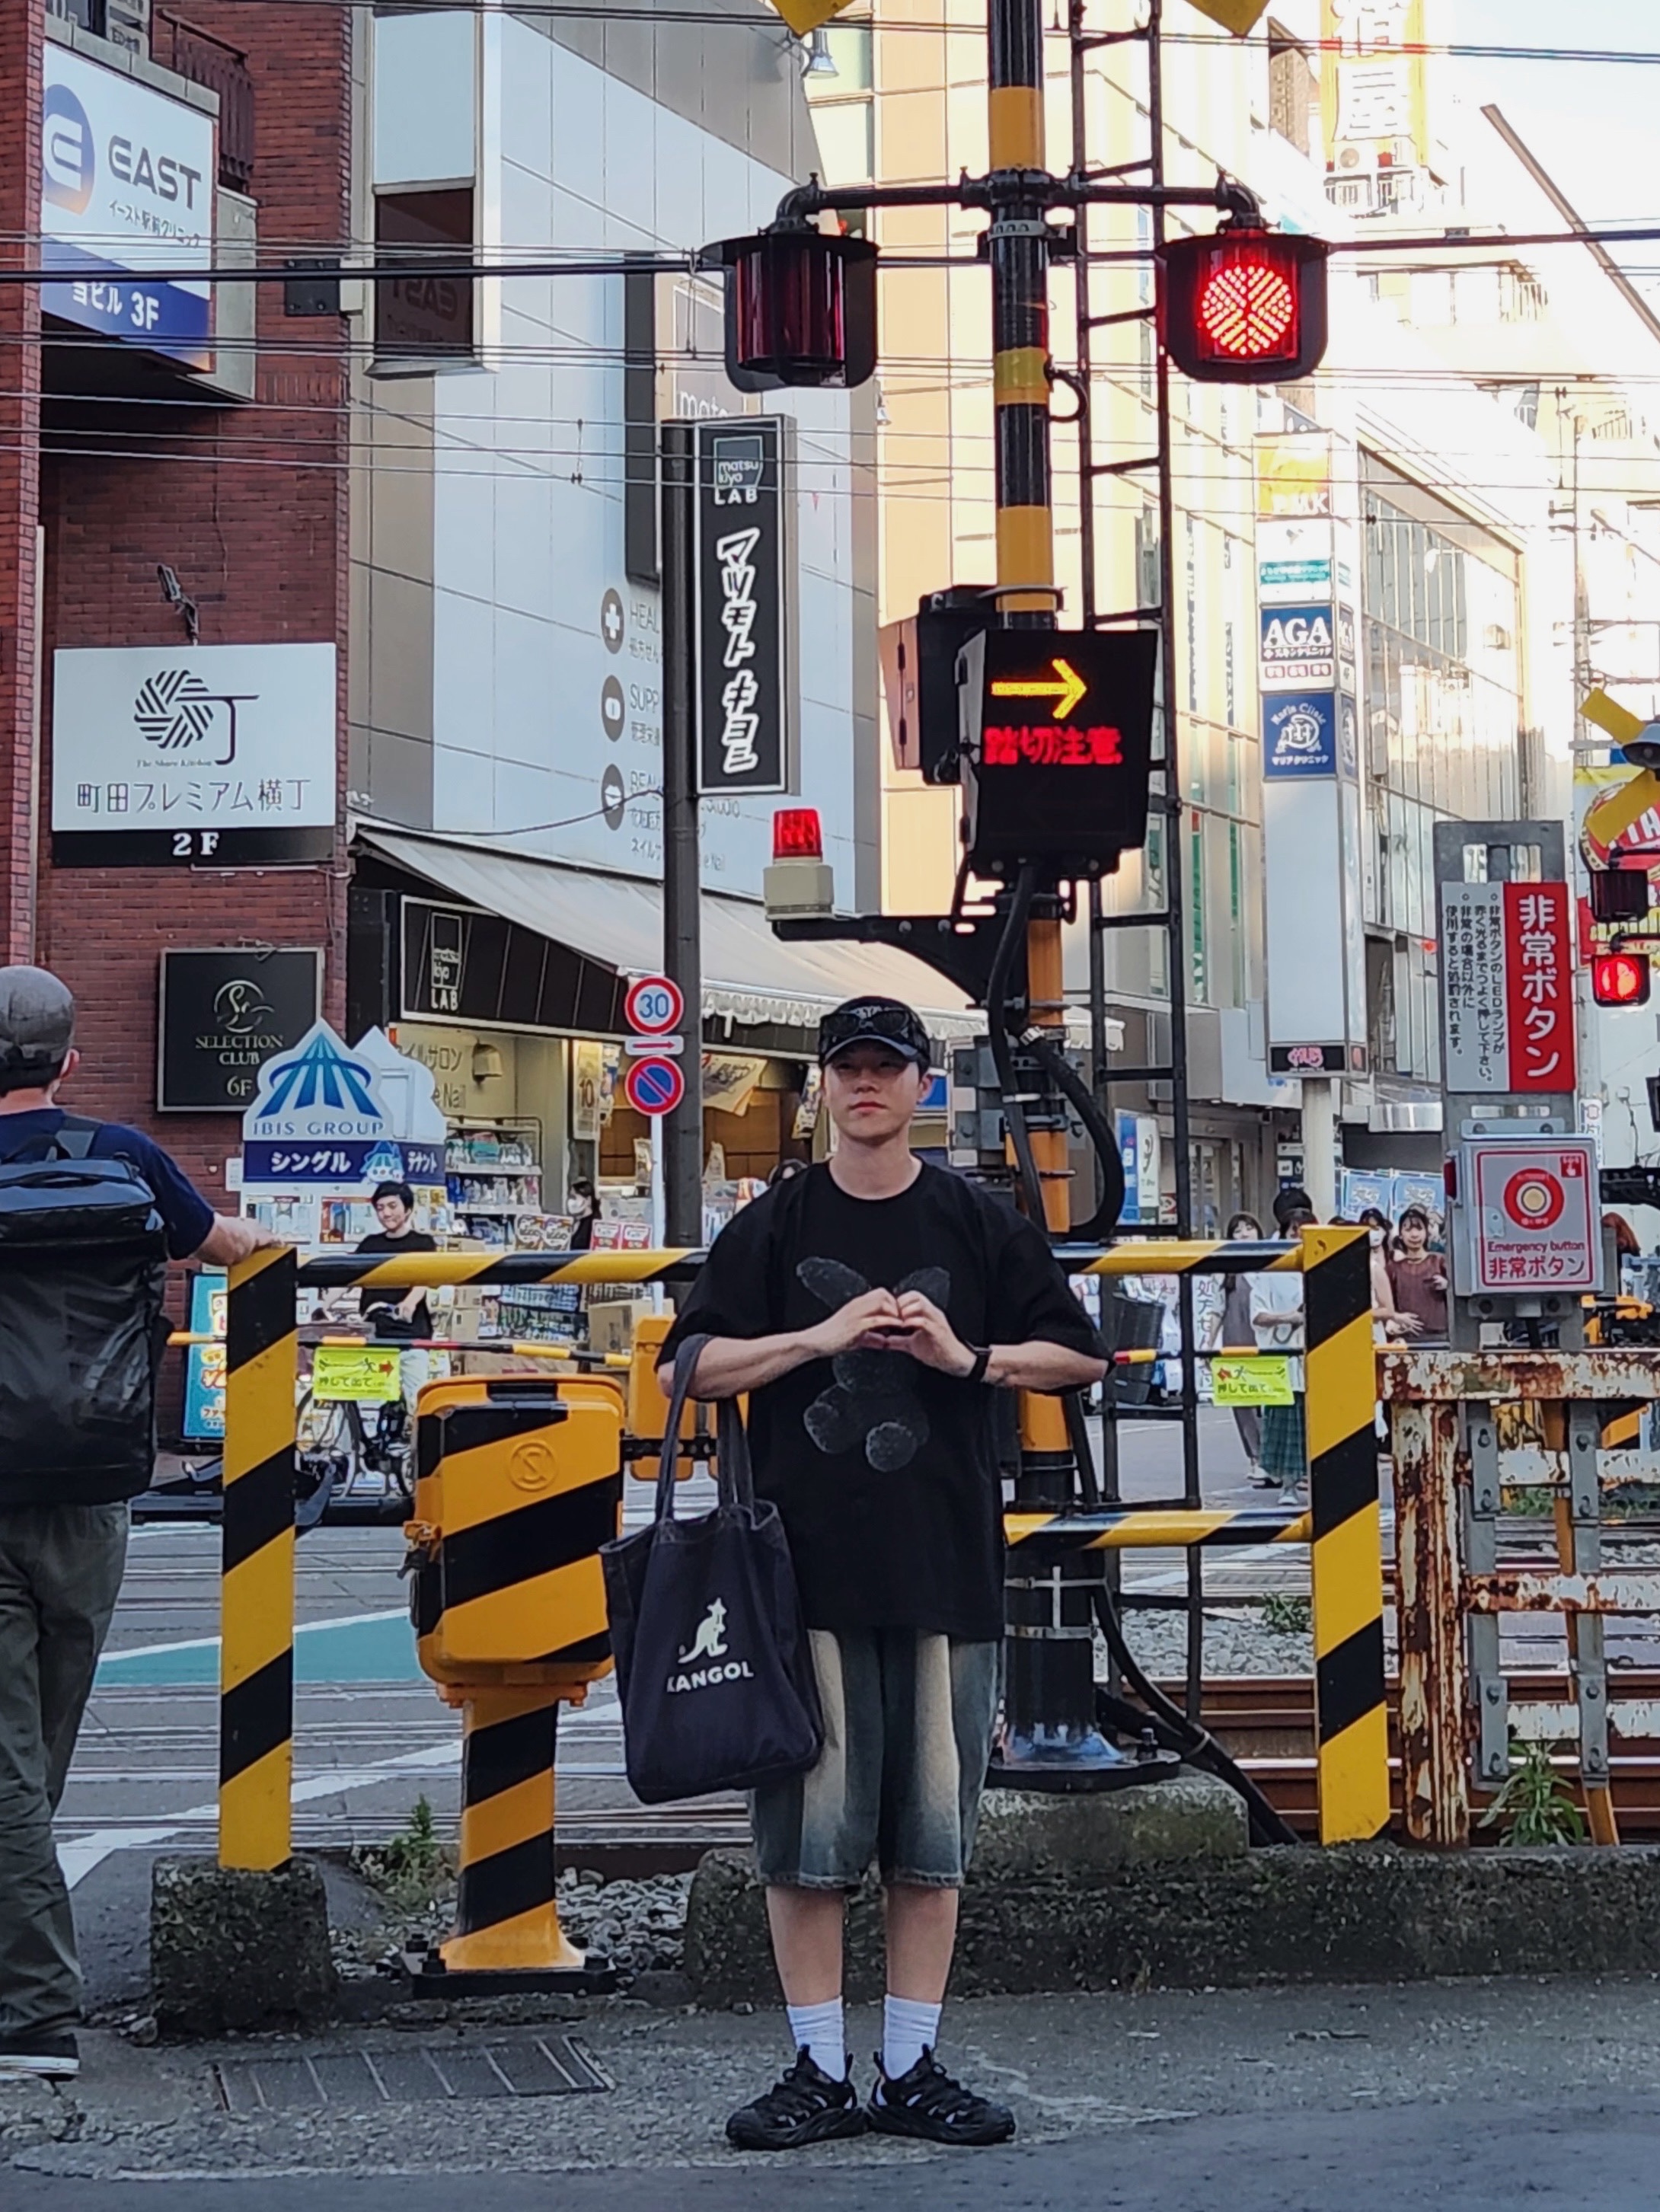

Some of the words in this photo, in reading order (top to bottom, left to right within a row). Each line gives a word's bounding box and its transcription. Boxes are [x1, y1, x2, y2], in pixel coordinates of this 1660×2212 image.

[108, 135, 202, 210] EAST
[130, 291, 159, 330] 3F
[715, 487, 758, 505] LAB
[1263, 617, 1333, 647] AGA
[984, 726, 1123, 765] 踏切注意
[77, 778, 311, 814] 町田プレミアム横丁
[1519, 894, 1559, 1077] 非常ボタン
[431, 988, 458, 1011] LAB
[639, 993, 669, 1019] 30
[195, 1034, 283, 1049] SELECTION
[219, 1051, 260, 1065] CLUB
[227, 1075, 253, 1096] 6F
[253, 1122, 295, 1135] IBIS
[307, 1122, 384, 1135] GROUP
[271, 1151, 352, 1173] シングル
[1487, 1241, 1547, 1254] Emergency
[1550, 1240, 1585, 1251] button
[1489, 1255, 1585, 1279] 非常ボタン
